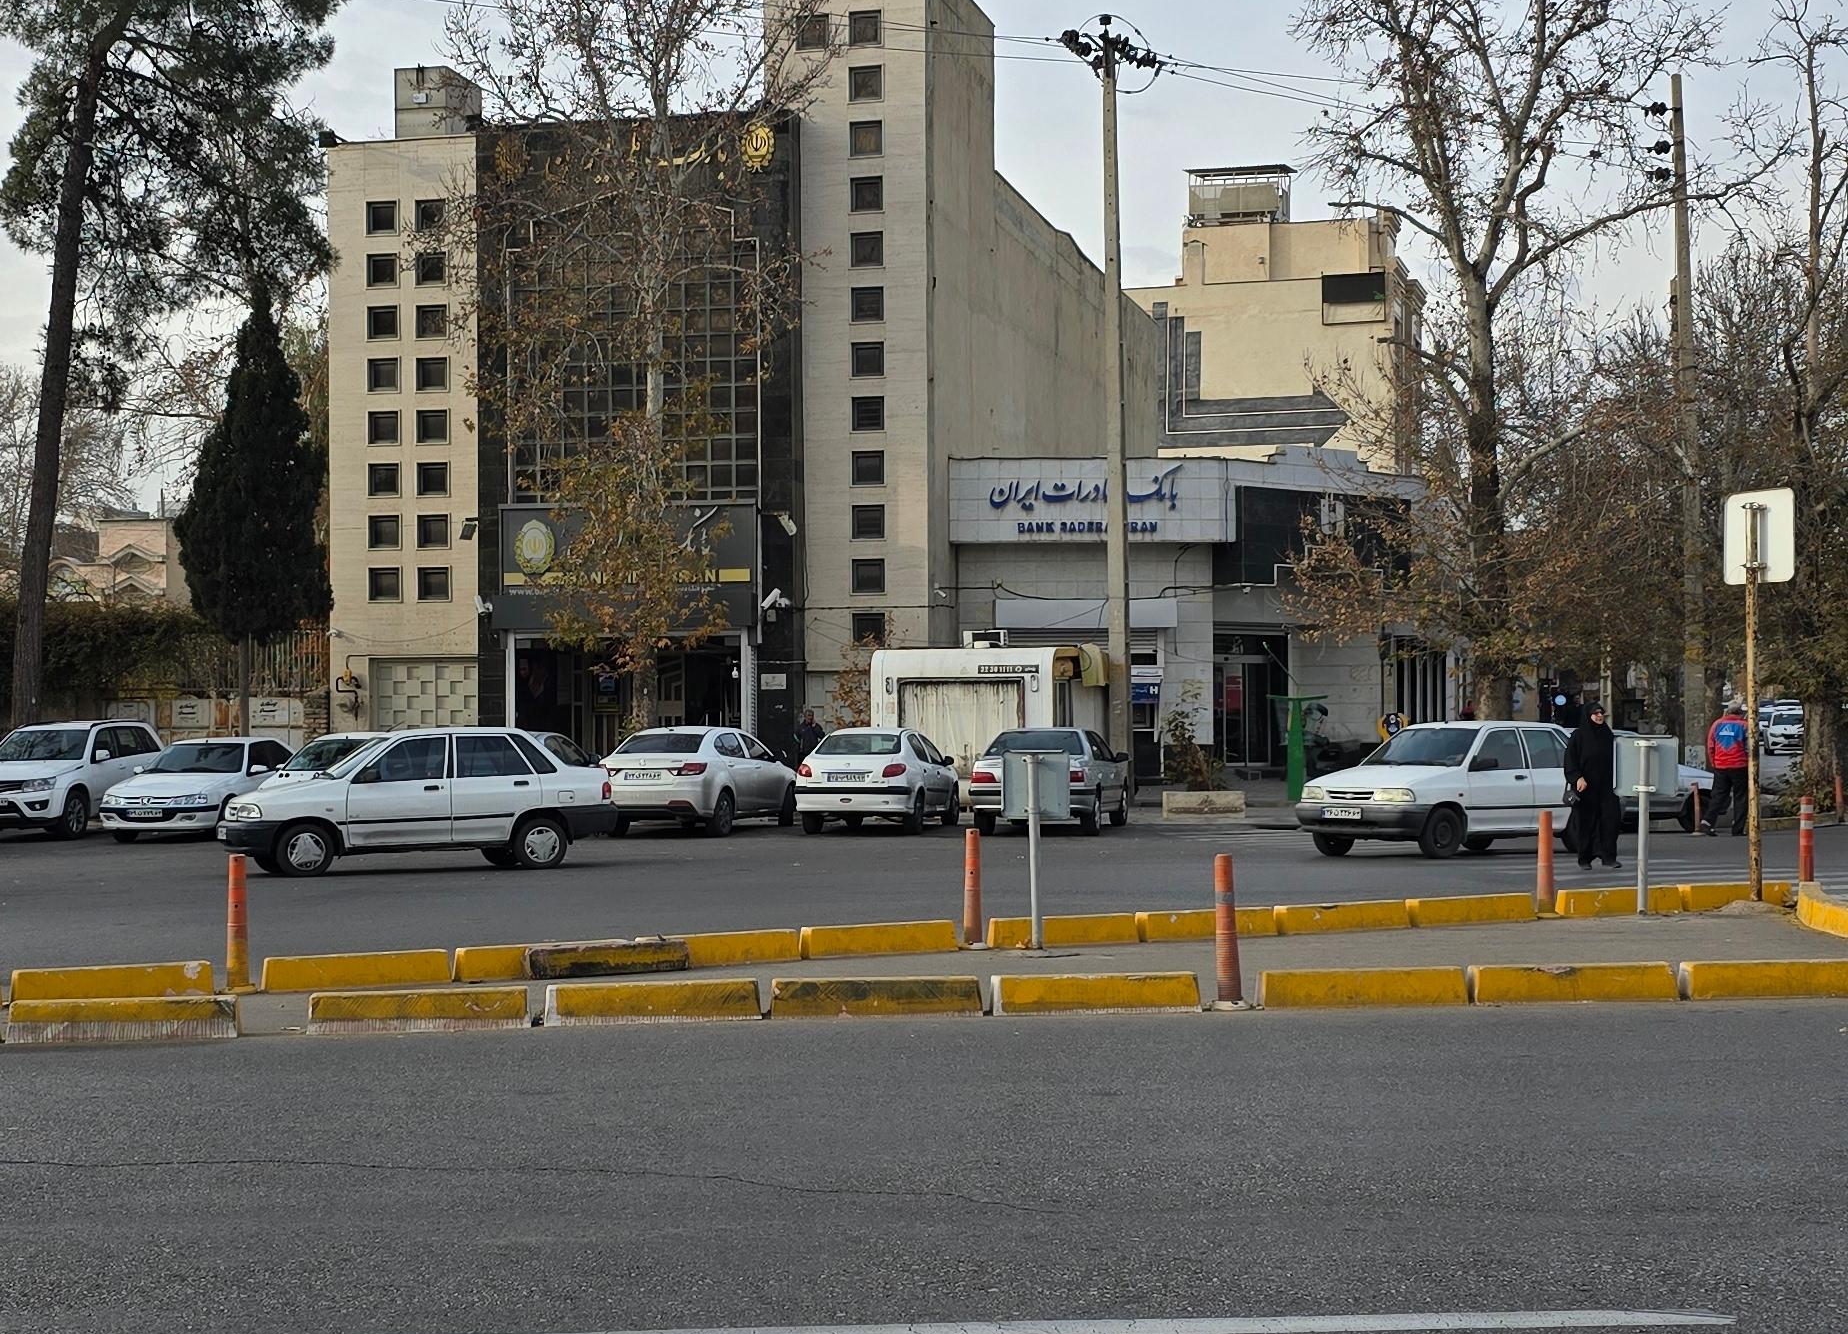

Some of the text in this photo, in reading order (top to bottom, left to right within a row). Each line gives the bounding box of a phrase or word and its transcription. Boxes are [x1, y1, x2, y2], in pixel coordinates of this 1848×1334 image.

[989, 480, 1041, 512] ایران
[1042, 478, 1107, 504] ادرات
[1017, 521, 1055, 534] BANK
[1060, 521, 1108, 533] SADER
